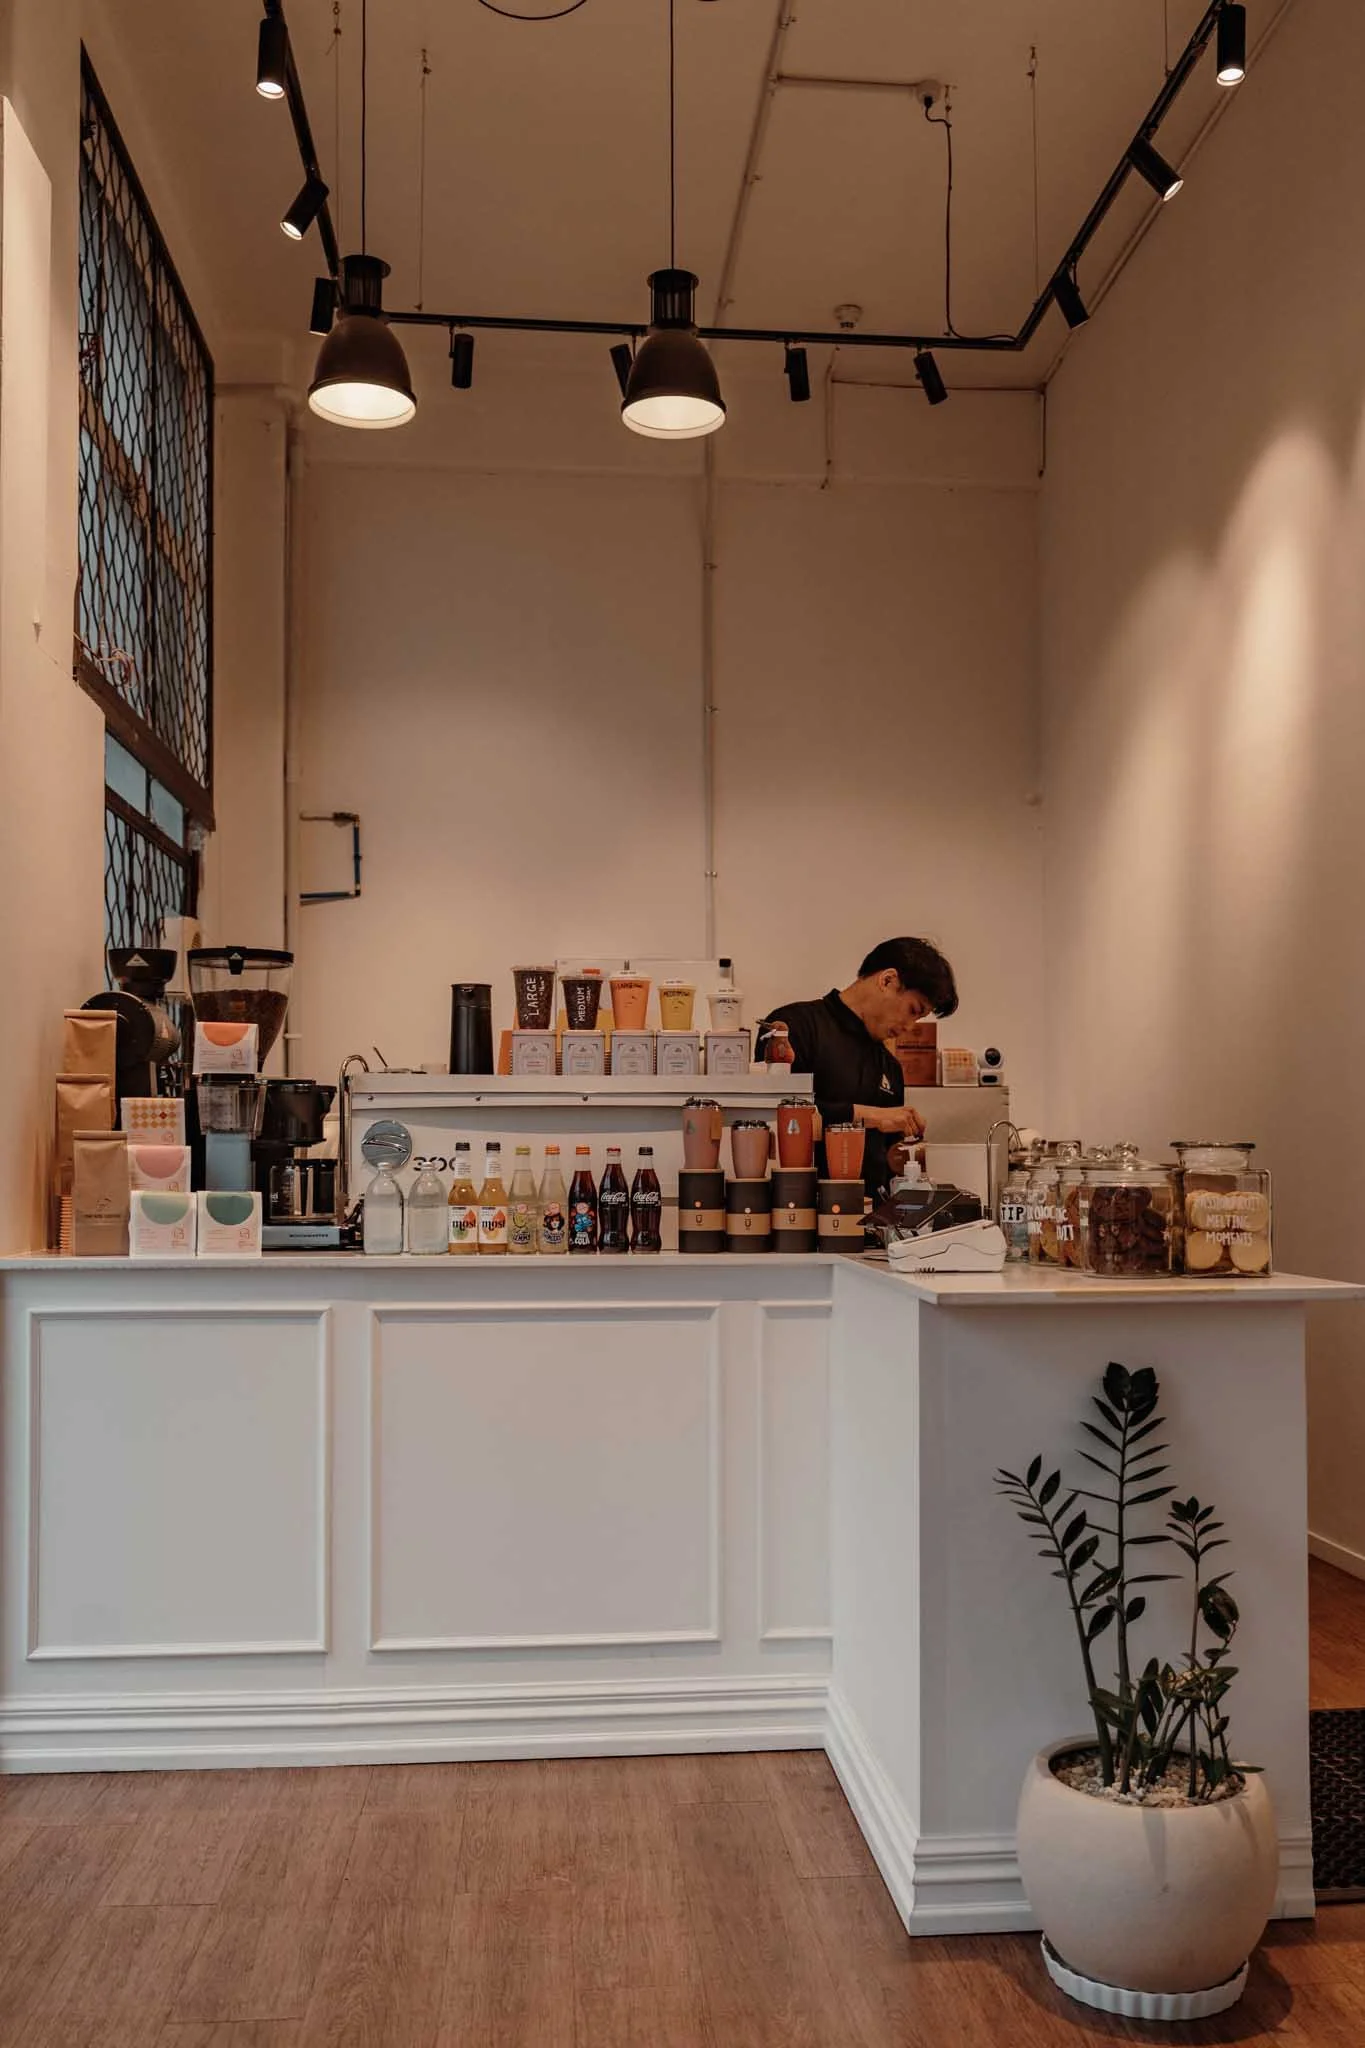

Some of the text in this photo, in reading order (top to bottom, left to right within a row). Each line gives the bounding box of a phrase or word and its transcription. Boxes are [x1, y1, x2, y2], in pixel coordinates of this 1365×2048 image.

[526, 977, 539, 1016] LARGE
[577, 987, 586, 1022] MEDIUM
[574, 1238, 590, 1246] COLA
[1205, 1231, 1253, 1247] MOMENTS
